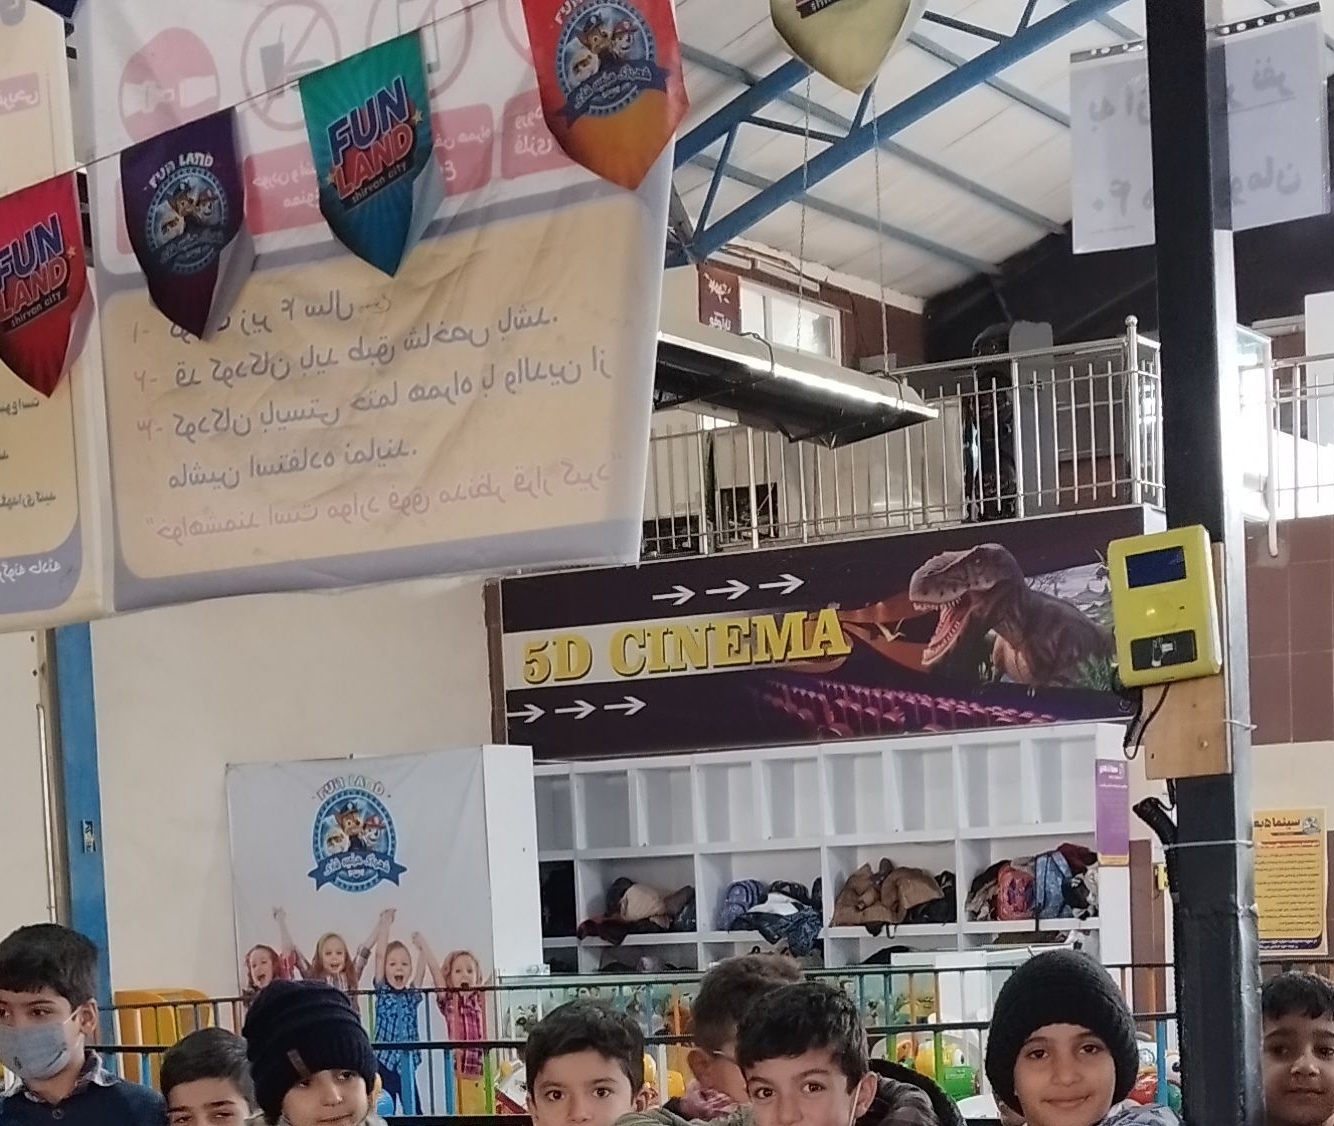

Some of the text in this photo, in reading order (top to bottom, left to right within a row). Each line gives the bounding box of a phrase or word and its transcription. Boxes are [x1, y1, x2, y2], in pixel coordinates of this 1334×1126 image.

[325, 74, 409, 168] FUN
[331, 122, 413, 200] LAND
[351, 170, 386, 205] shirvan
[11, 300, 44, 328] shirvan
[523, 607, 852, 684] 5D CINEMA
[1272, 816, 1301, 831] سینما
